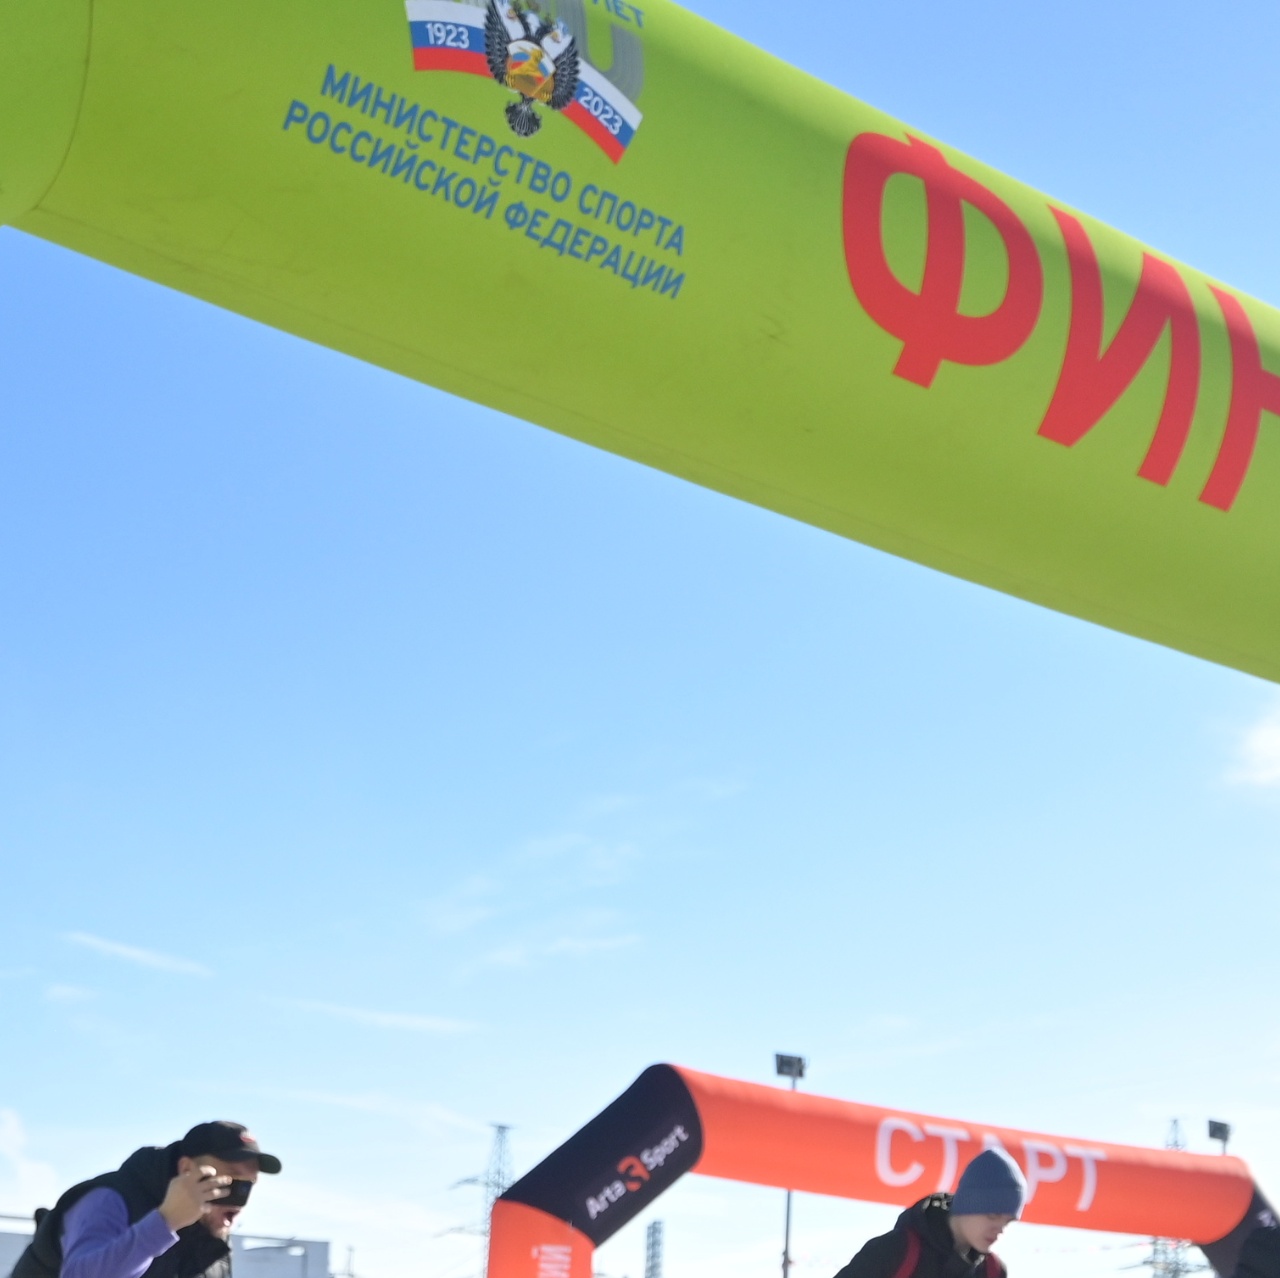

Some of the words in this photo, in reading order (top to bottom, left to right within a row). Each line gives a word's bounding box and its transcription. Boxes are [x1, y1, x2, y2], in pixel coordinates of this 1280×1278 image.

[426, 22, 470, 49] 1923
[578, 87, 623, 135] 2023
[282, 99, 504, 219] РОССИЙСКОЙ
[504, 200, 686, 300] ФЕДЕРАЦИИ
[320, 63, 573, 203] МИНИСТЕРСТВО
[578, 183, 686, 258] СПОРТА
[585, 1179, 626, 1220] Arta
[640, 1124, 689, 1171] Sport
